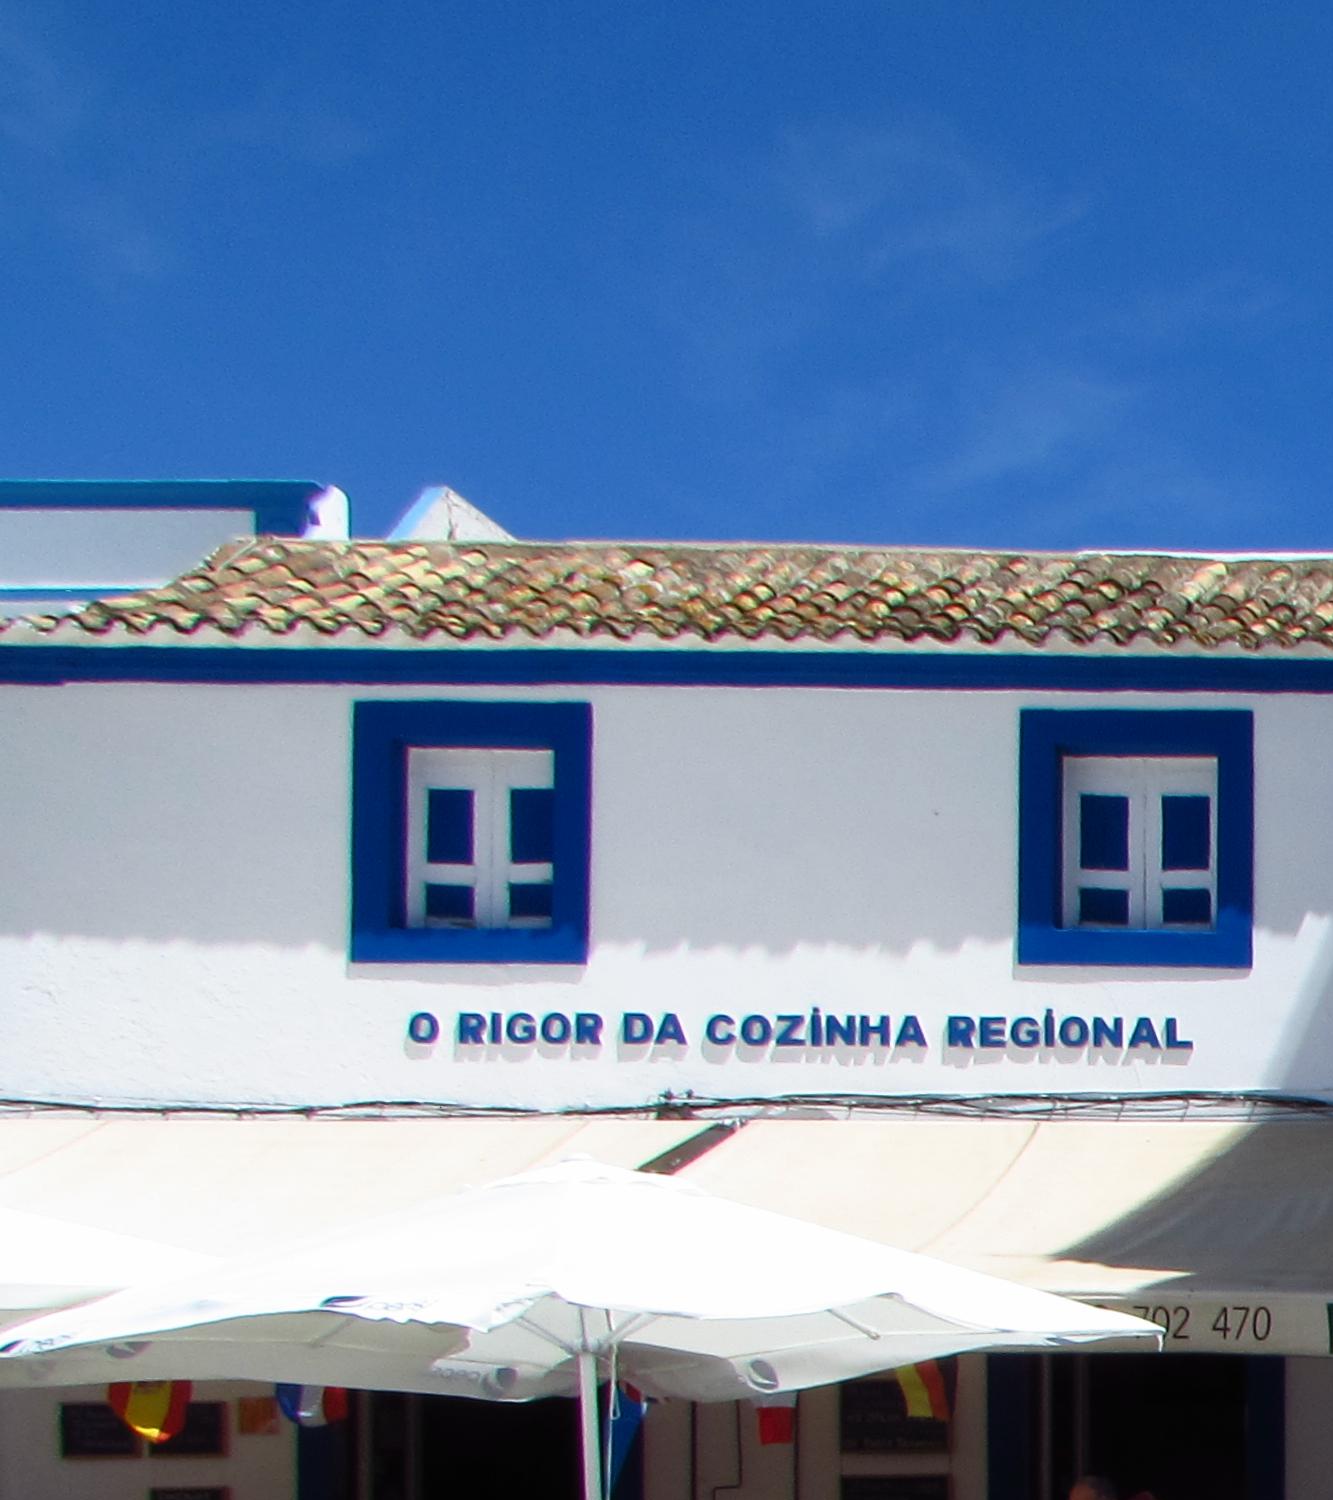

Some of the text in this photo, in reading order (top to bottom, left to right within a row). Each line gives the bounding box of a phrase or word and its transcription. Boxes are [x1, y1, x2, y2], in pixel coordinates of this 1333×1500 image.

[407, 1011, 441, 1045] O
[457, 1011, 605, 1046] RIGOR
[621, 1011, 689, 1046] DA
[1212, 1306, 1272, 1342] 470
